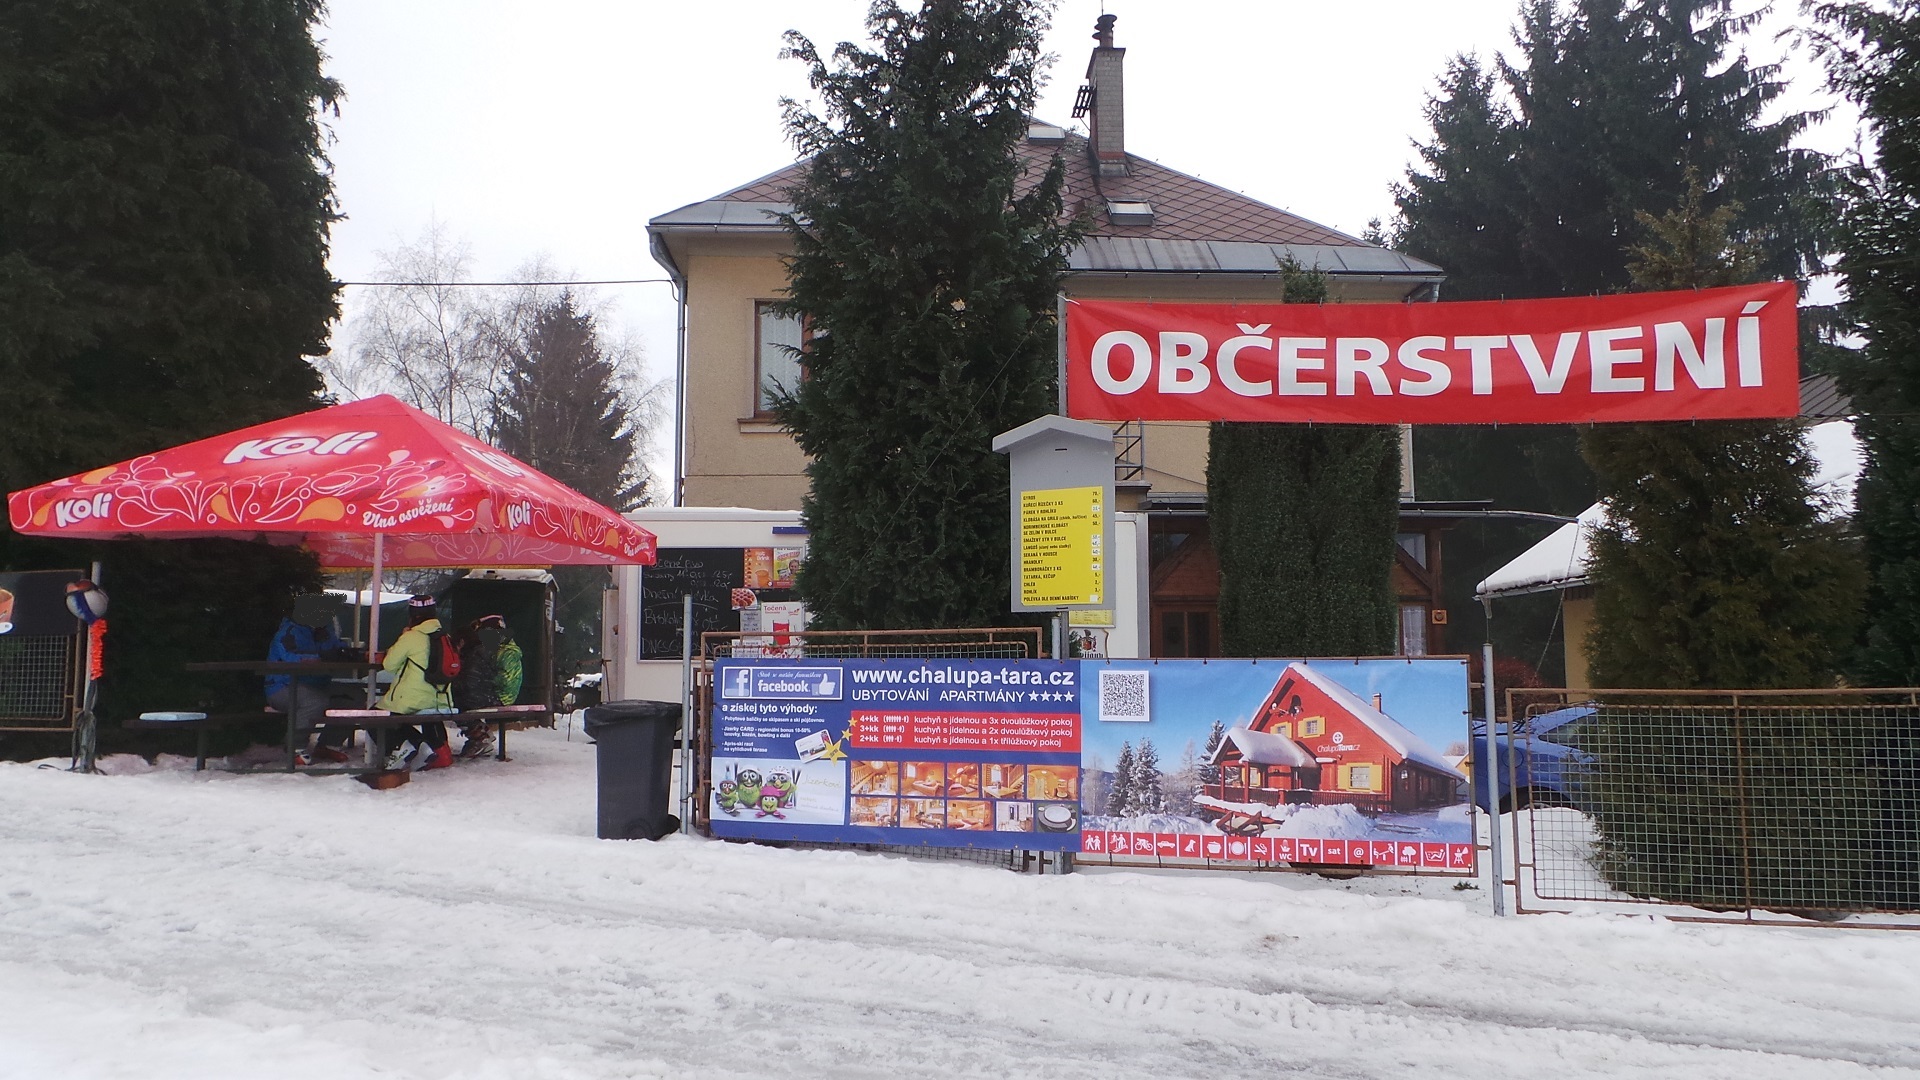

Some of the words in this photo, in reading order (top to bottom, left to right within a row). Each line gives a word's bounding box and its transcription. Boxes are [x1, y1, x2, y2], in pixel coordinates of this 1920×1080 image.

[1090, 301, 1769, 397] OBČERSTVENÍ
[223, 432, 379, 464] Koli
[55, 492, 113, 528] Koli
[363, 511, 396, 529] Vlna
[398, 498, 455, 524] osvěžení
[506, 500, 531, 531] Koli
[852, 666, 1074, 688] www.chalupa-tara.cz
[758, 680, 809, 692] facebook
[852, 688, 929, 702] UBYTOVÁNÍ
[940, 689, 1025, 703] APARTMÁNY
[730, 703, 757, 714] získej
[760, 704, 778, 714] tyto
[780, 704, 818, 715] výhody:
[860, 715, 879, 723] 4+kk
[914, 715, 941, 724] kuchyň
[949, 716, 980, 725] jídelnou
[1001, 717, 1049, 726] dvoulůžkový
[1051, 718, 1073, 727] pokoj
[860, 725, 879, 733] 3+kk
[914, 725, 941, 734] kuchyň
[949, 726, 980, 735] jídelnou
[989, 727, 999, 735] 2x
[1001, 727, 1049, 737] dvoulůžkový
[1051, 729, 1073, 737] pokoj
[914, 736, 941, 745] kuchyň
[949, 736, 980, 745] jídelnou
[990, 737, 999, 745] 1x
[1040, 738, 1062, 747] pokoj
[1300, 844, 1318, 857] Tv
